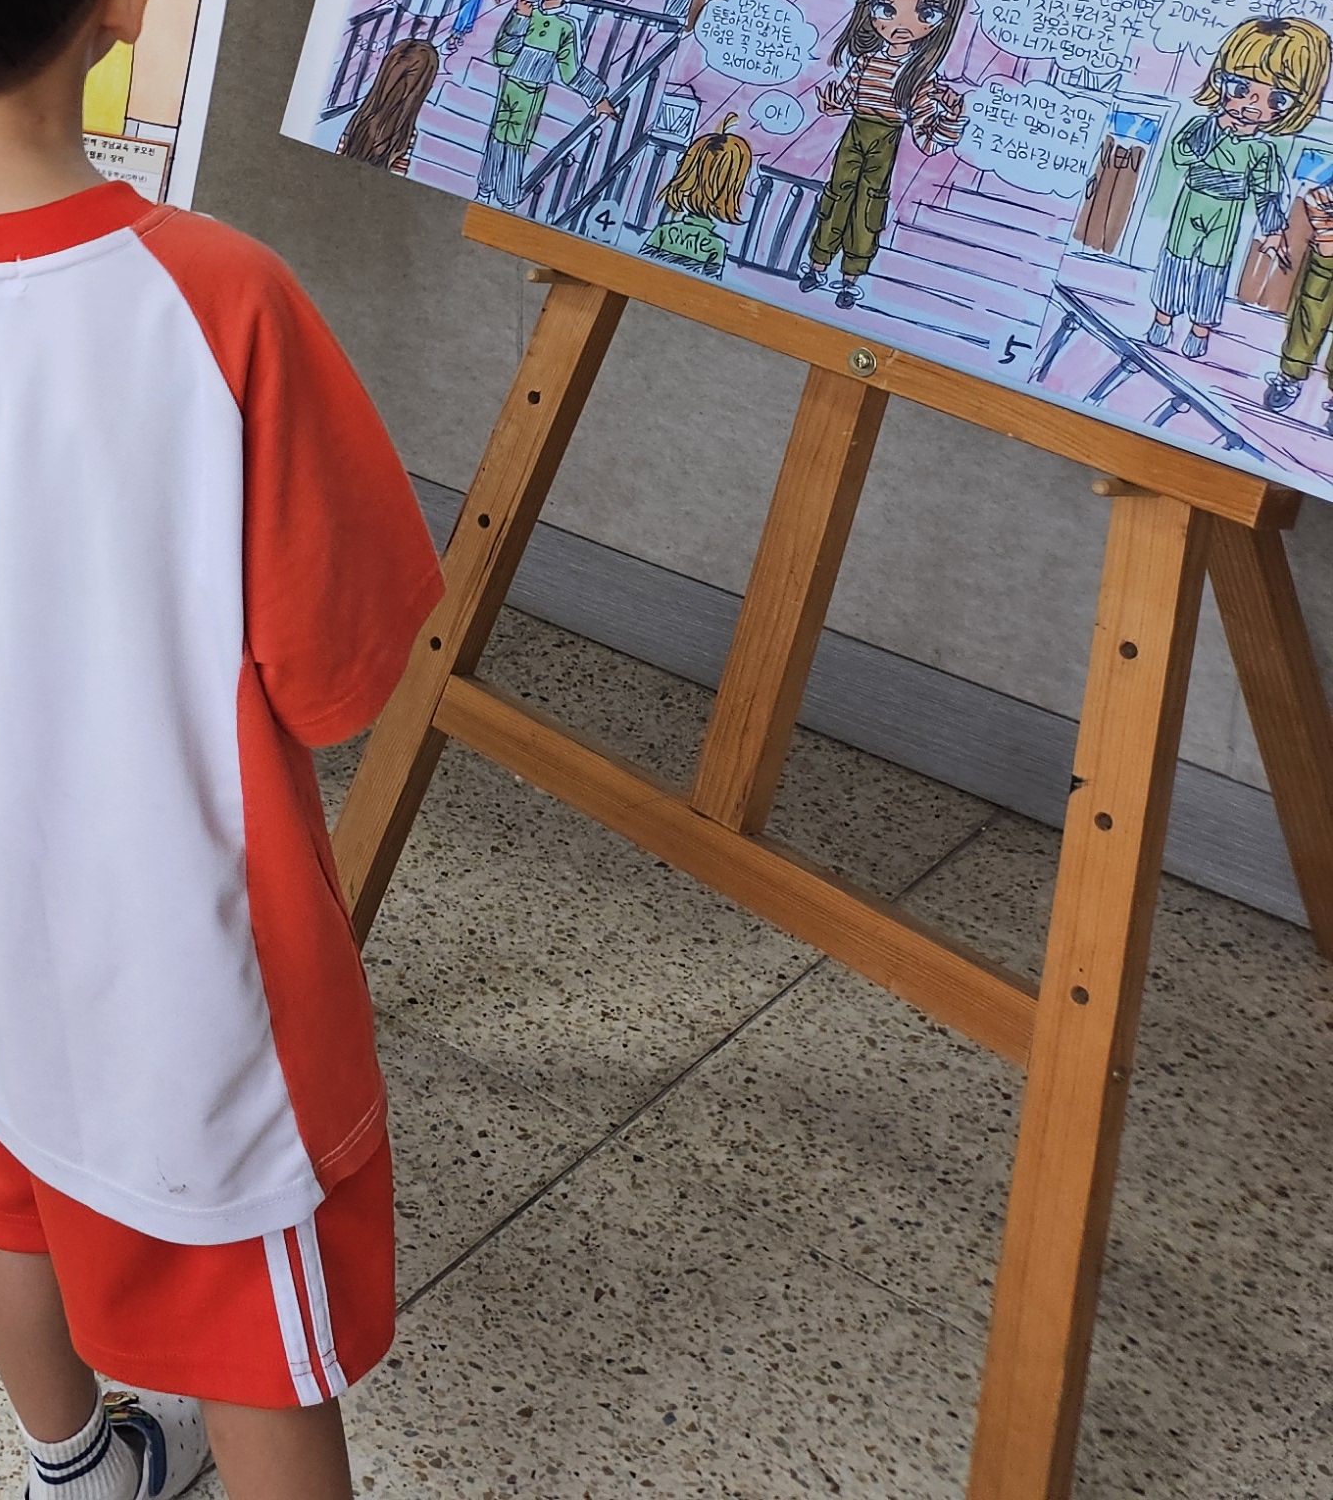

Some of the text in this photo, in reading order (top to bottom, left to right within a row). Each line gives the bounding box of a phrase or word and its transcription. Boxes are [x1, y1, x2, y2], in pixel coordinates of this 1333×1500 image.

[775, 10, 791, 22] 다
[701, 22, 734, 46] 위험은
[1023, 34, 1058, 52] 너가
[765, 104, 791, 125] 아!
[1060, 104, 1095, 133] 정말
[134, 145, 156, 156] 공모전
[595, 209, 615, 231] 4
[997, 334, 1032, 365] 5
